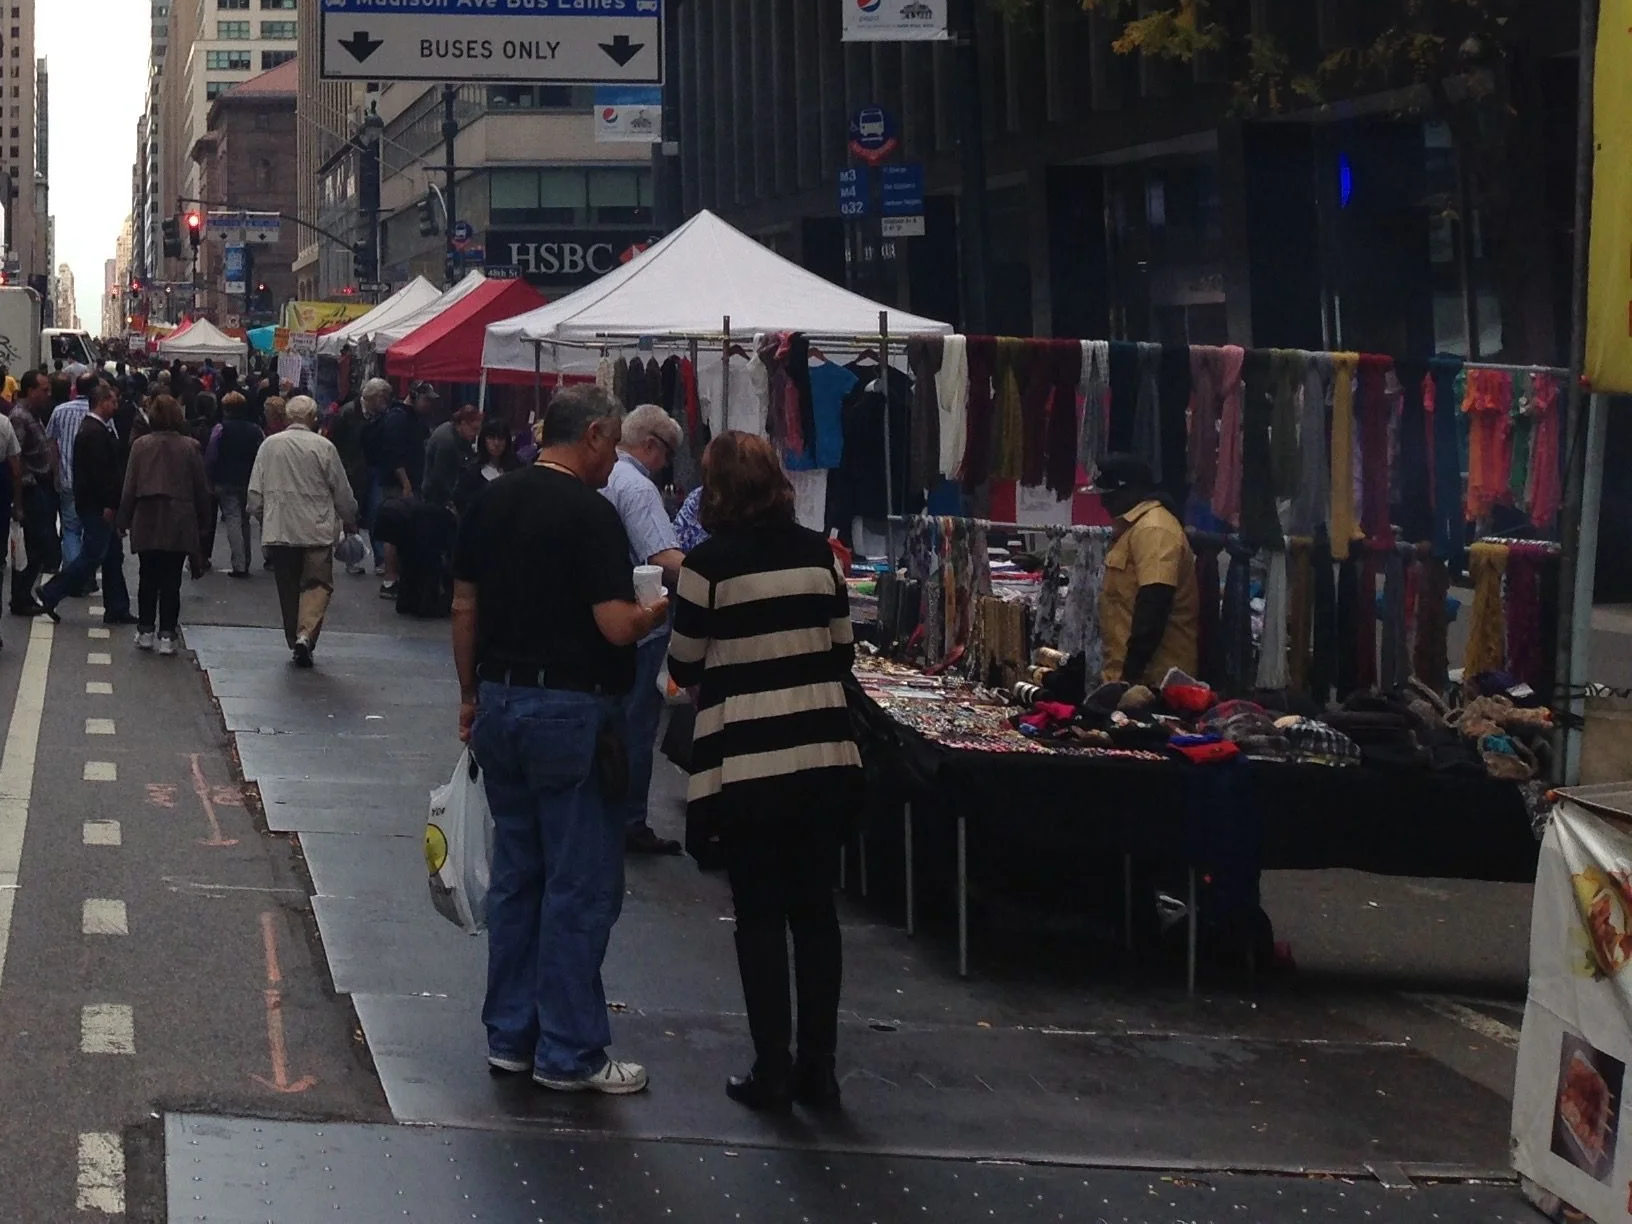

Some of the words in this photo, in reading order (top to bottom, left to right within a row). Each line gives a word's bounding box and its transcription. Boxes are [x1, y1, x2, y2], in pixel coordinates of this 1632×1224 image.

[420, 39, 493, 59] BUSES
[502, 40, 560, 60] ONLY
[839, 169, 857, 182] M3
[840, 185, 857, 198] M4
[840, 201, 864, 215] Q32
[508, 242, 615, 275] HSBC
